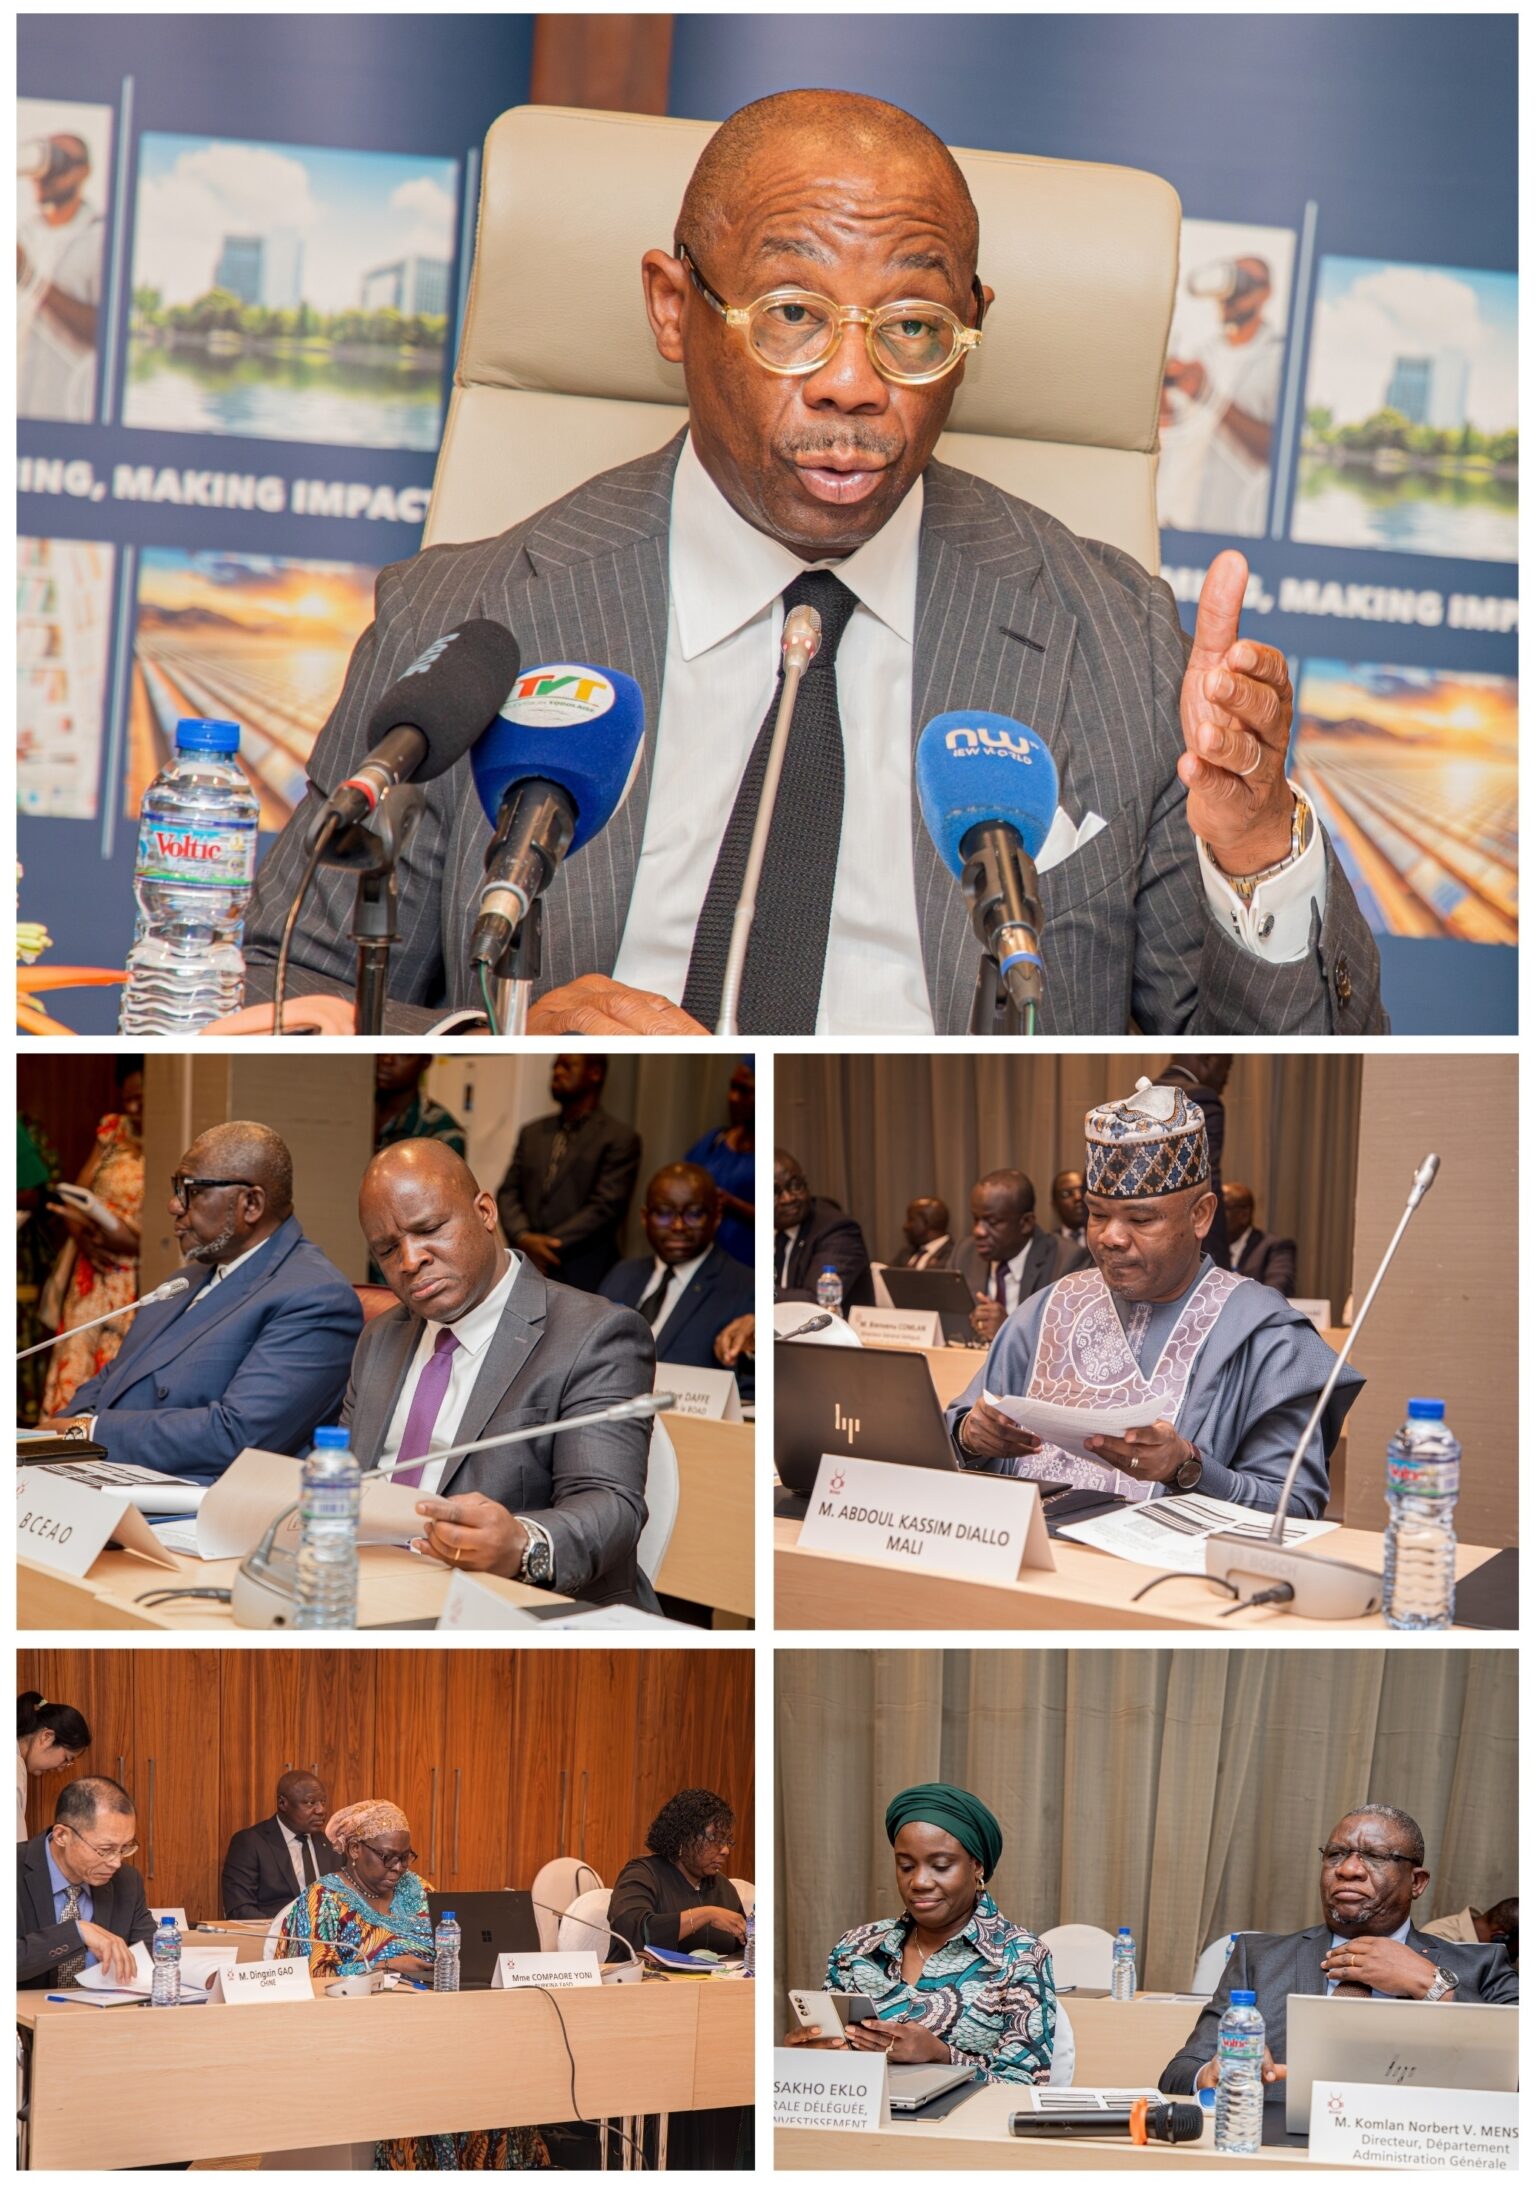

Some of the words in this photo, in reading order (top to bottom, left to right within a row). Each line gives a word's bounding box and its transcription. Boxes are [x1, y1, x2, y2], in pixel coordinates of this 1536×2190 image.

[112, 464, 286, 514] MAKING
[1278, 577, 1445, 627] MAKING
[518, 674, 607, 702] TVT
[156, 831, 222, 861] Voltic
[18, 1512, 73, 1544] BCEAO
[818, 1501, 835, 1518] M.
[837, 1504, 894, 1528] ABDOUL
[898, 1514, 953, 1537] KASSIM
[955, 1523, 1010, 1547] DIALLO
[886, 1535, 924, 1556] MALI
[239, 1972, 249, 1981] M.
[277, 1966, 294, 1976] GAO
[512, 1974, 531, 1982] Mme
[532, 1972, 573, 1981] COMPAORE
[574, 1971, 593, 1980] YONI
[774, 2081, 825, 2096] SAKHO
[830, 2083, 868, 2097] EKLO
[804, 2100, 868, 2117] DÉLÉGUÉE,
[1335, 2117, 1351, 2128] M.
[1355, 2117, 1405, 2132] Komlan
[1408, 2121, 1460, 2136] Norbert
[1463, 2125, 1478, 2137] V.
[1480, 2126, 1519, 2139] MENS
[1361, 2134, 1422, 2150] Directeur,
[1426, 2137, 1511, 2155] Département
[1352, 2149, 1446, 2167] Administration
[1449, 2155, 1507, 2170] Générale
